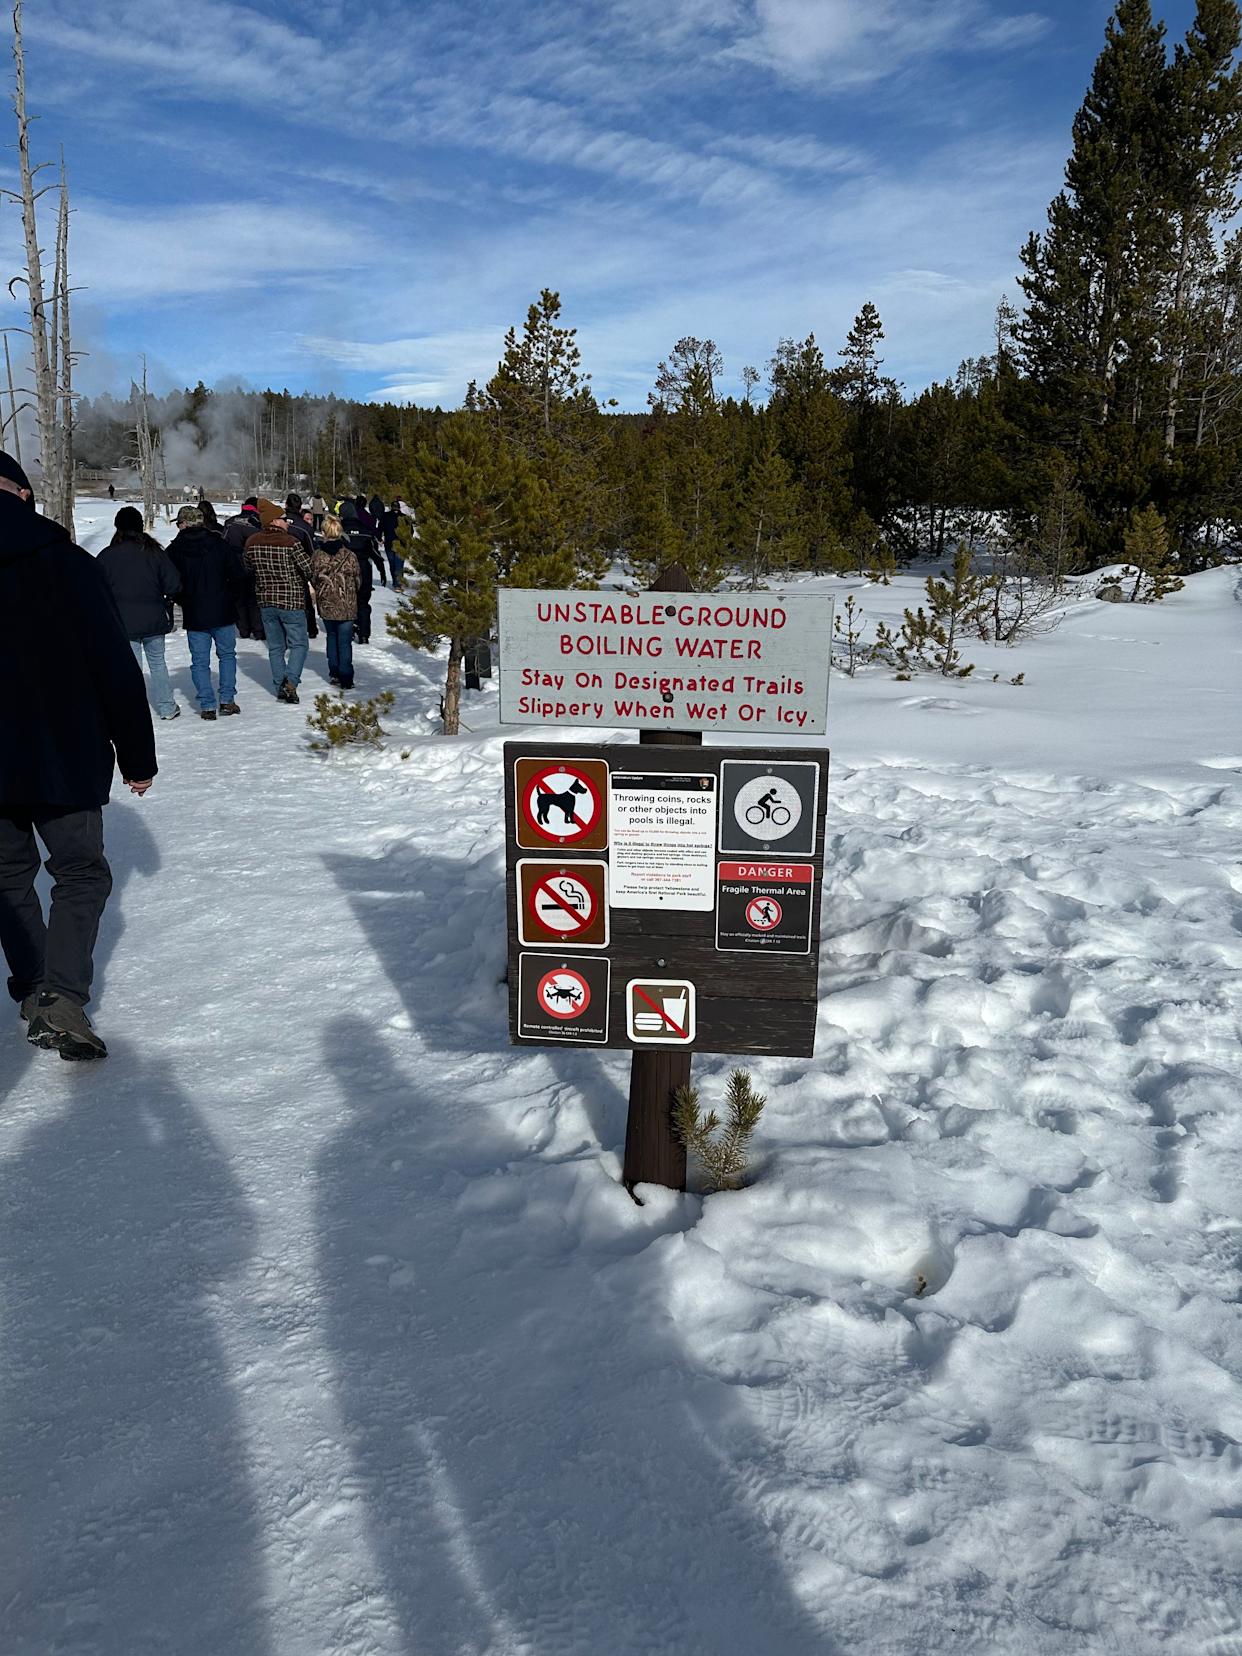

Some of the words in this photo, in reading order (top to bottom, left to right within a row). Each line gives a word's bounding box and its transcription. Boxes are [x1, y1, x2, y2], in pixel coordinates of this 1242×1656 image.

[537, 603, 665, 625] UNSTABLE
[678, 606, 786, 629] GROUND
[560, 635, 662, 657] BOILING
[676, 638, 762, 659] WATER
[521, 669, 564, 688] Stay
[576, 672, 602, 688] On
[615, 672, 734, 694] Designated
[744, 676, 803, 695] Trails
[519, 697, 603, 718] Slippery
[615, 701, 674, 719] When
[687, 703, 727, 720] Wet
[739, 704, 766, 721] Or
[778, 706, 814, 726] Icy.
[614, 794, 654, 803] Throwing
[658, 795, 684, 804] coins,
[655, 806, 687, 815] objects
[629, 816, 653, 824] pools
[667, 817, 695, 826] illegal.
[738, 867, 792, 877] DANGER
[722, 885, 749, 894] Fragile
